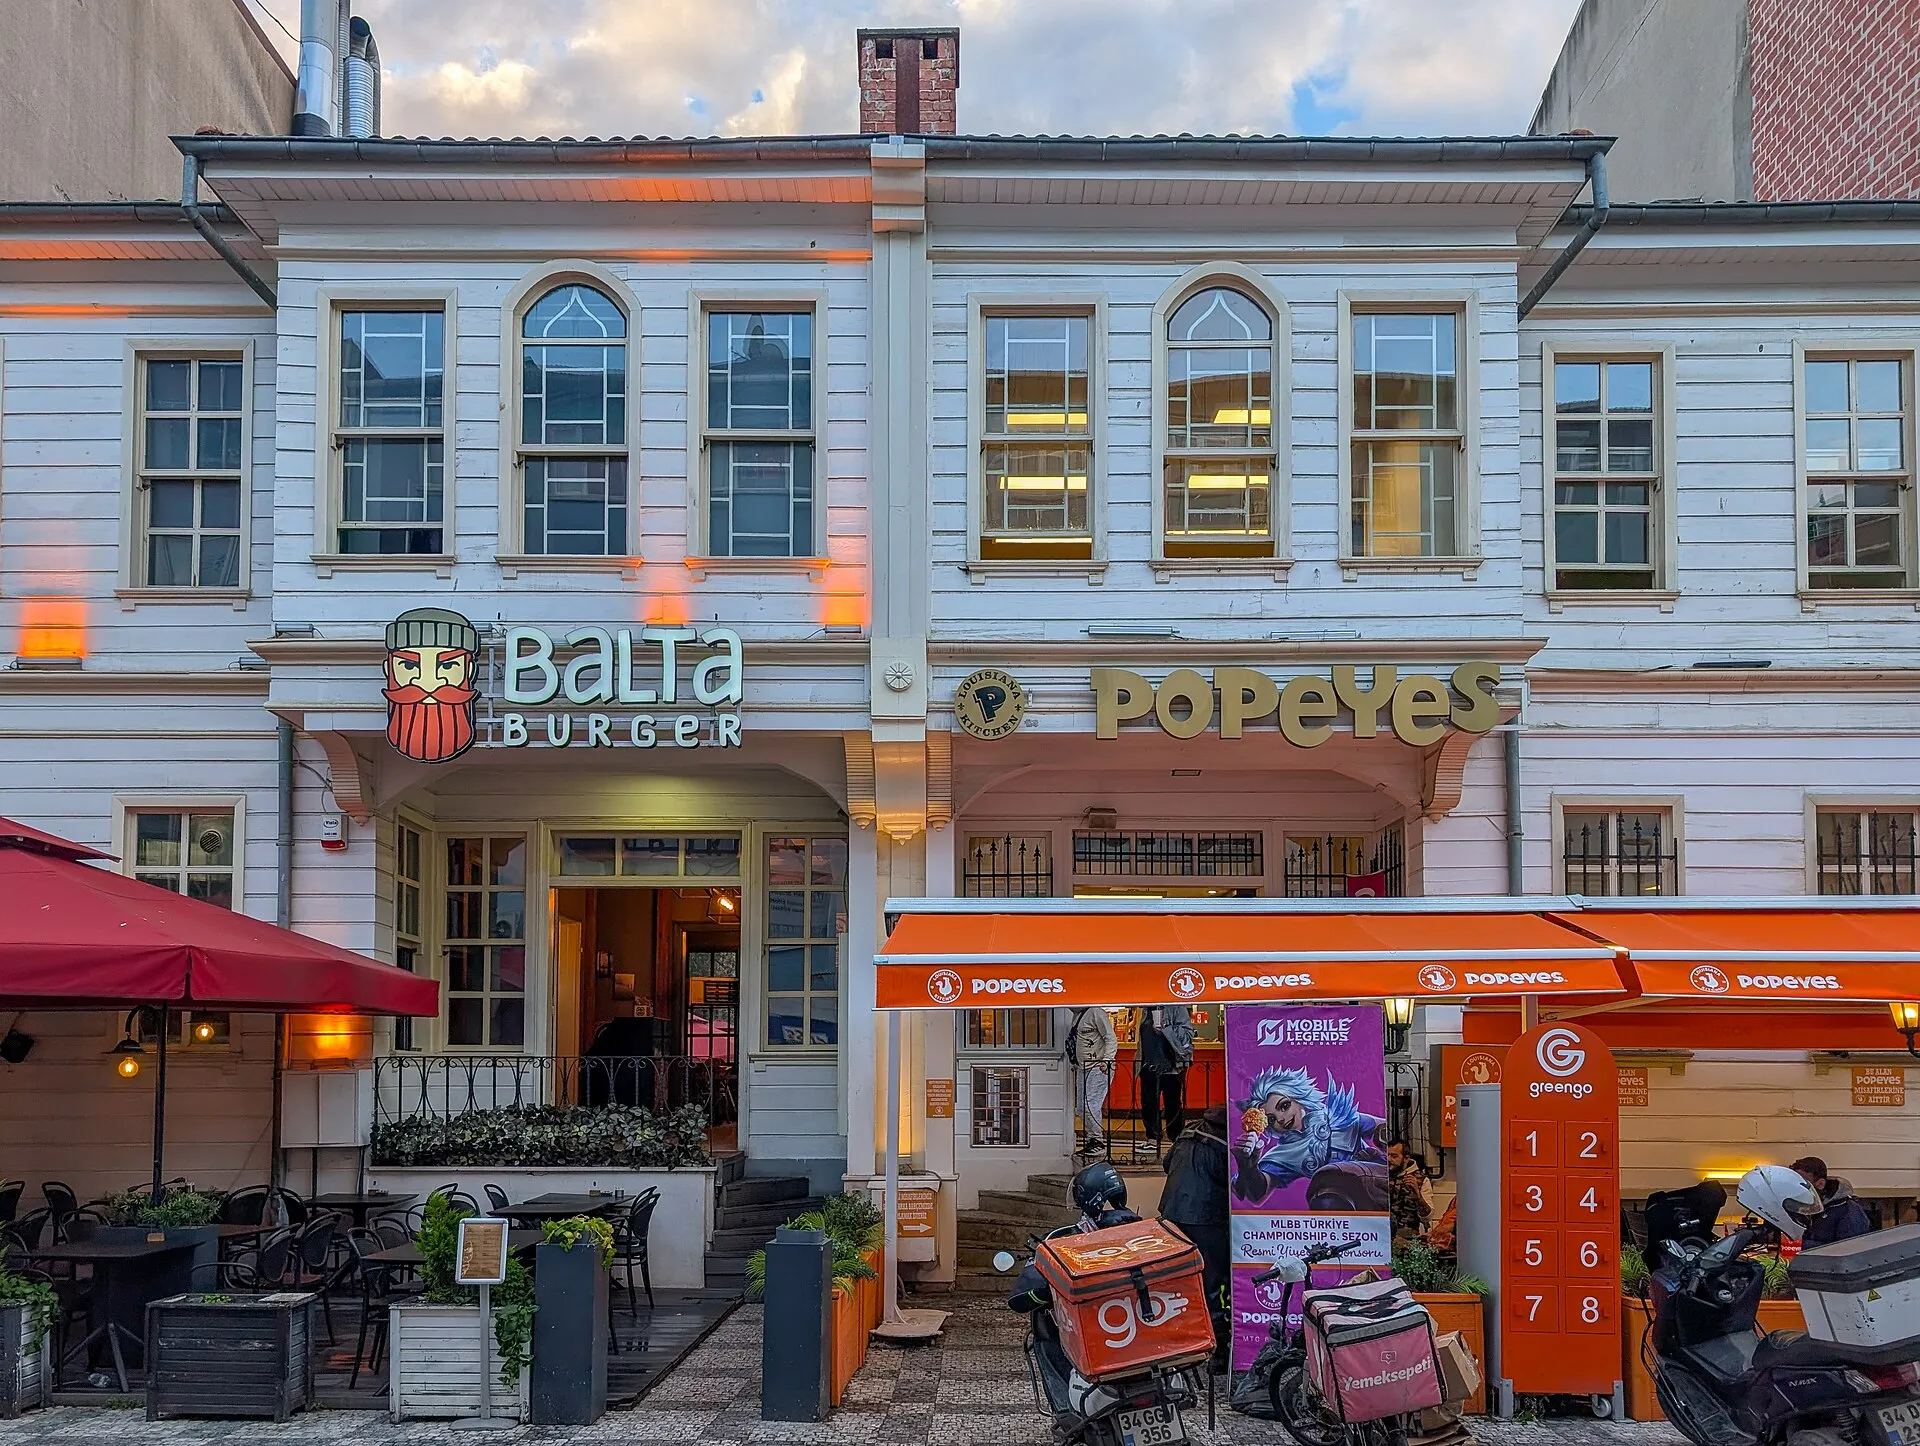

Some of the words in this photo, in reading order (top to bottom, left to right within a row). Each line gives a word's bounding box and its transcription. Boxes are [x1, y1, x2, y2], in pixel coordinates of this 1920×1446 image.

[958, 671, 1021, 700] LOUISIANA
[1091, 661, 1501, 748] POPeYeS
[503, 713, 742, 748] BURGeR
[960, 714, 1019, 737] KITCHEN
[932, 971, 958, 981] LOUISIANA
[1173, 968, 1200, 979] LOUISIANA
[933, 993, 957, 1002] KITCHEN
[1286, 1017, 1357, 1032] MOBILE
[1286, 1031, 1350, 1042] LEGENDS
[1467, 1055, 1496, 1067] LOUISIANA
[1530, 1082, 1593, 1098] greengo
[1618, 1077, 1645, 1086] eYeS
[1618, 1087, 1648, 1095] İRLERİNE
[1618, 1096, 1634, 1104] TTİR
[1525, 1130, 1537, 1157] 1
[1579, 1132, 1598, 1158] 2
[1525, 1185, 1543, 1212] 3
[1579, 1187, 1598, 1213] 4
[1270, 1219, 1300, 1229] MLBB
[1303, 1218, 1349, 1229] TÜRKİYE
[1243, 1231, 1328, 1241] CHAMPIONSHIP
[1330, 1233, 1340, 1241] 6.
[1341, 1232, 1378, 1242] SEZON
[1240, 1243, 1276, 1258] Resmi
[1277, 1244, 1311, 1260] Yiye
[1525, 1240, 1543, 1266] 5
[1580, 1241, 1598, 1267] 6
[1525, 1295, 1543, 1322] 7
[1581, 1297, 1599, 1323] 8
[1098, 1291, 1189, 1348] go
[1241, 1312, 1303, 1325] POPeeS
[1343, 1356, 1432, 1391] Yemeksepeti
[1121, 1412, 1142, 1430] 34
[1882, 1408, 1905, 1426] 34
[1907, 1402, 1920, 1419] D
[1141, 1425, 1172, 1444] 356
